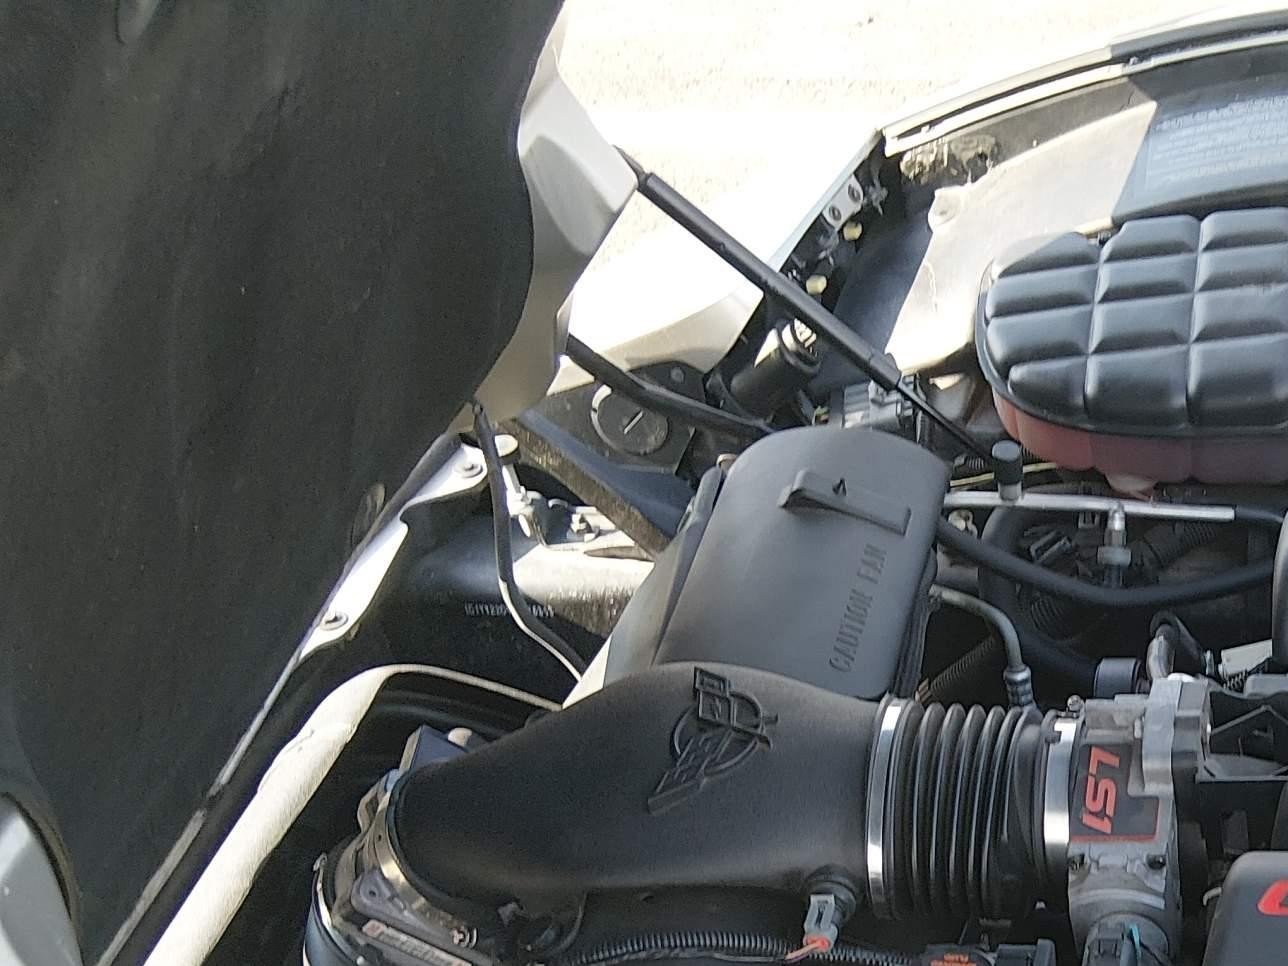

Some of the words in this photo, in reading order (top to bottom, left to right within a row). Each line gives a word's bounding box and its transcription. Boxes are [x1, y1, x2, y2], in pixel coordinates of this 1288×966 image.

[828, 588, 876, 674] CAUTION
[855, 543, 888, 586] FAN
[1081, 745, 1120, 834] LS1
